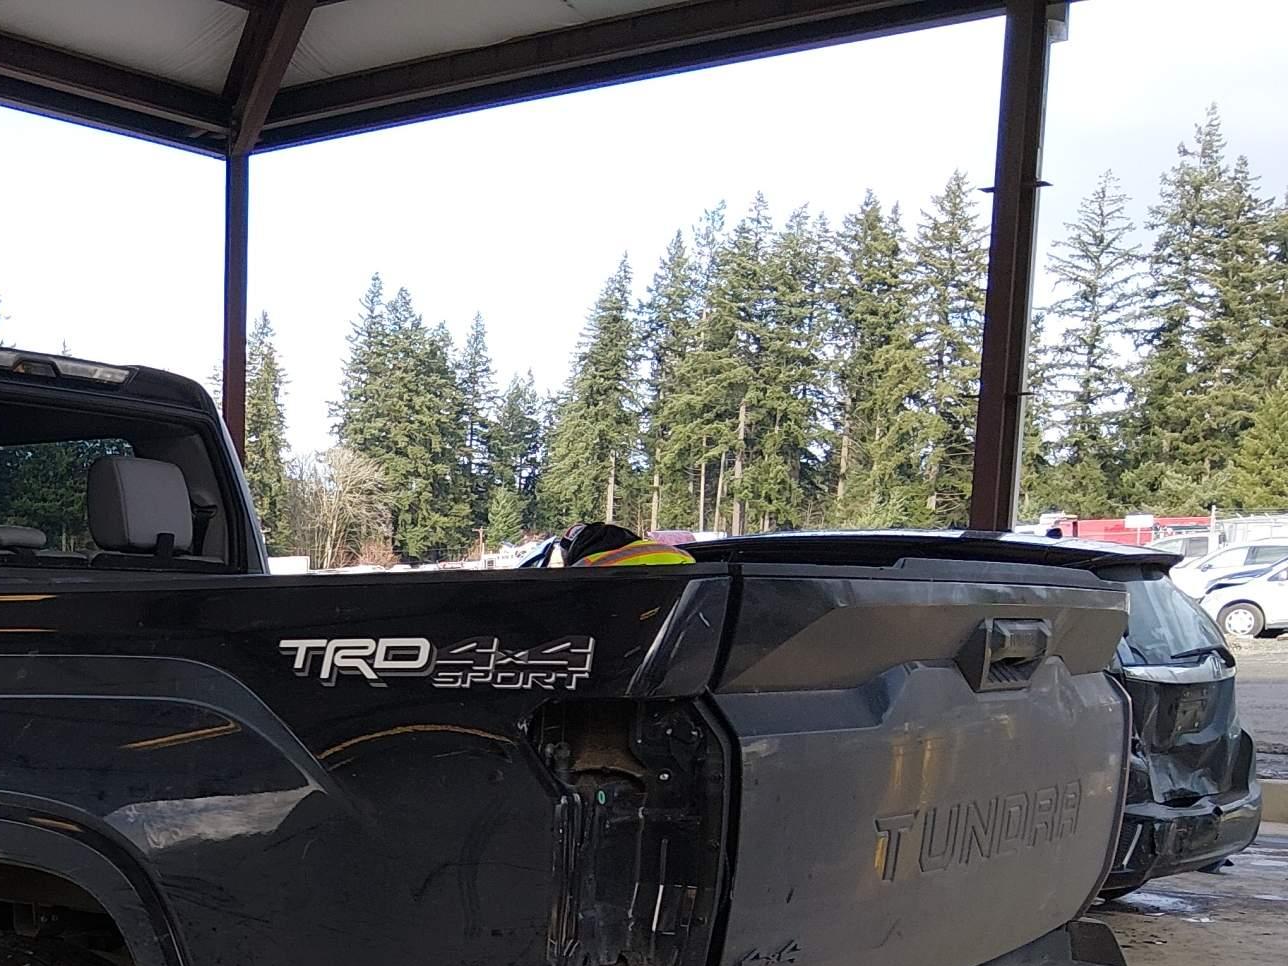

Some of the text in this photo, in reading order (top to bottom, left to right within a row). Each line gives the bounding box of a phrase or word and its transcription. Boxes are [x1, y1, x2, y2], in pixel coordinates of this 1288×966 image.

[279, 638, 437, 687] TRD
[432, 671, 589, 690] SPORT
[875, 778, 1082, 882] TUNDRA
